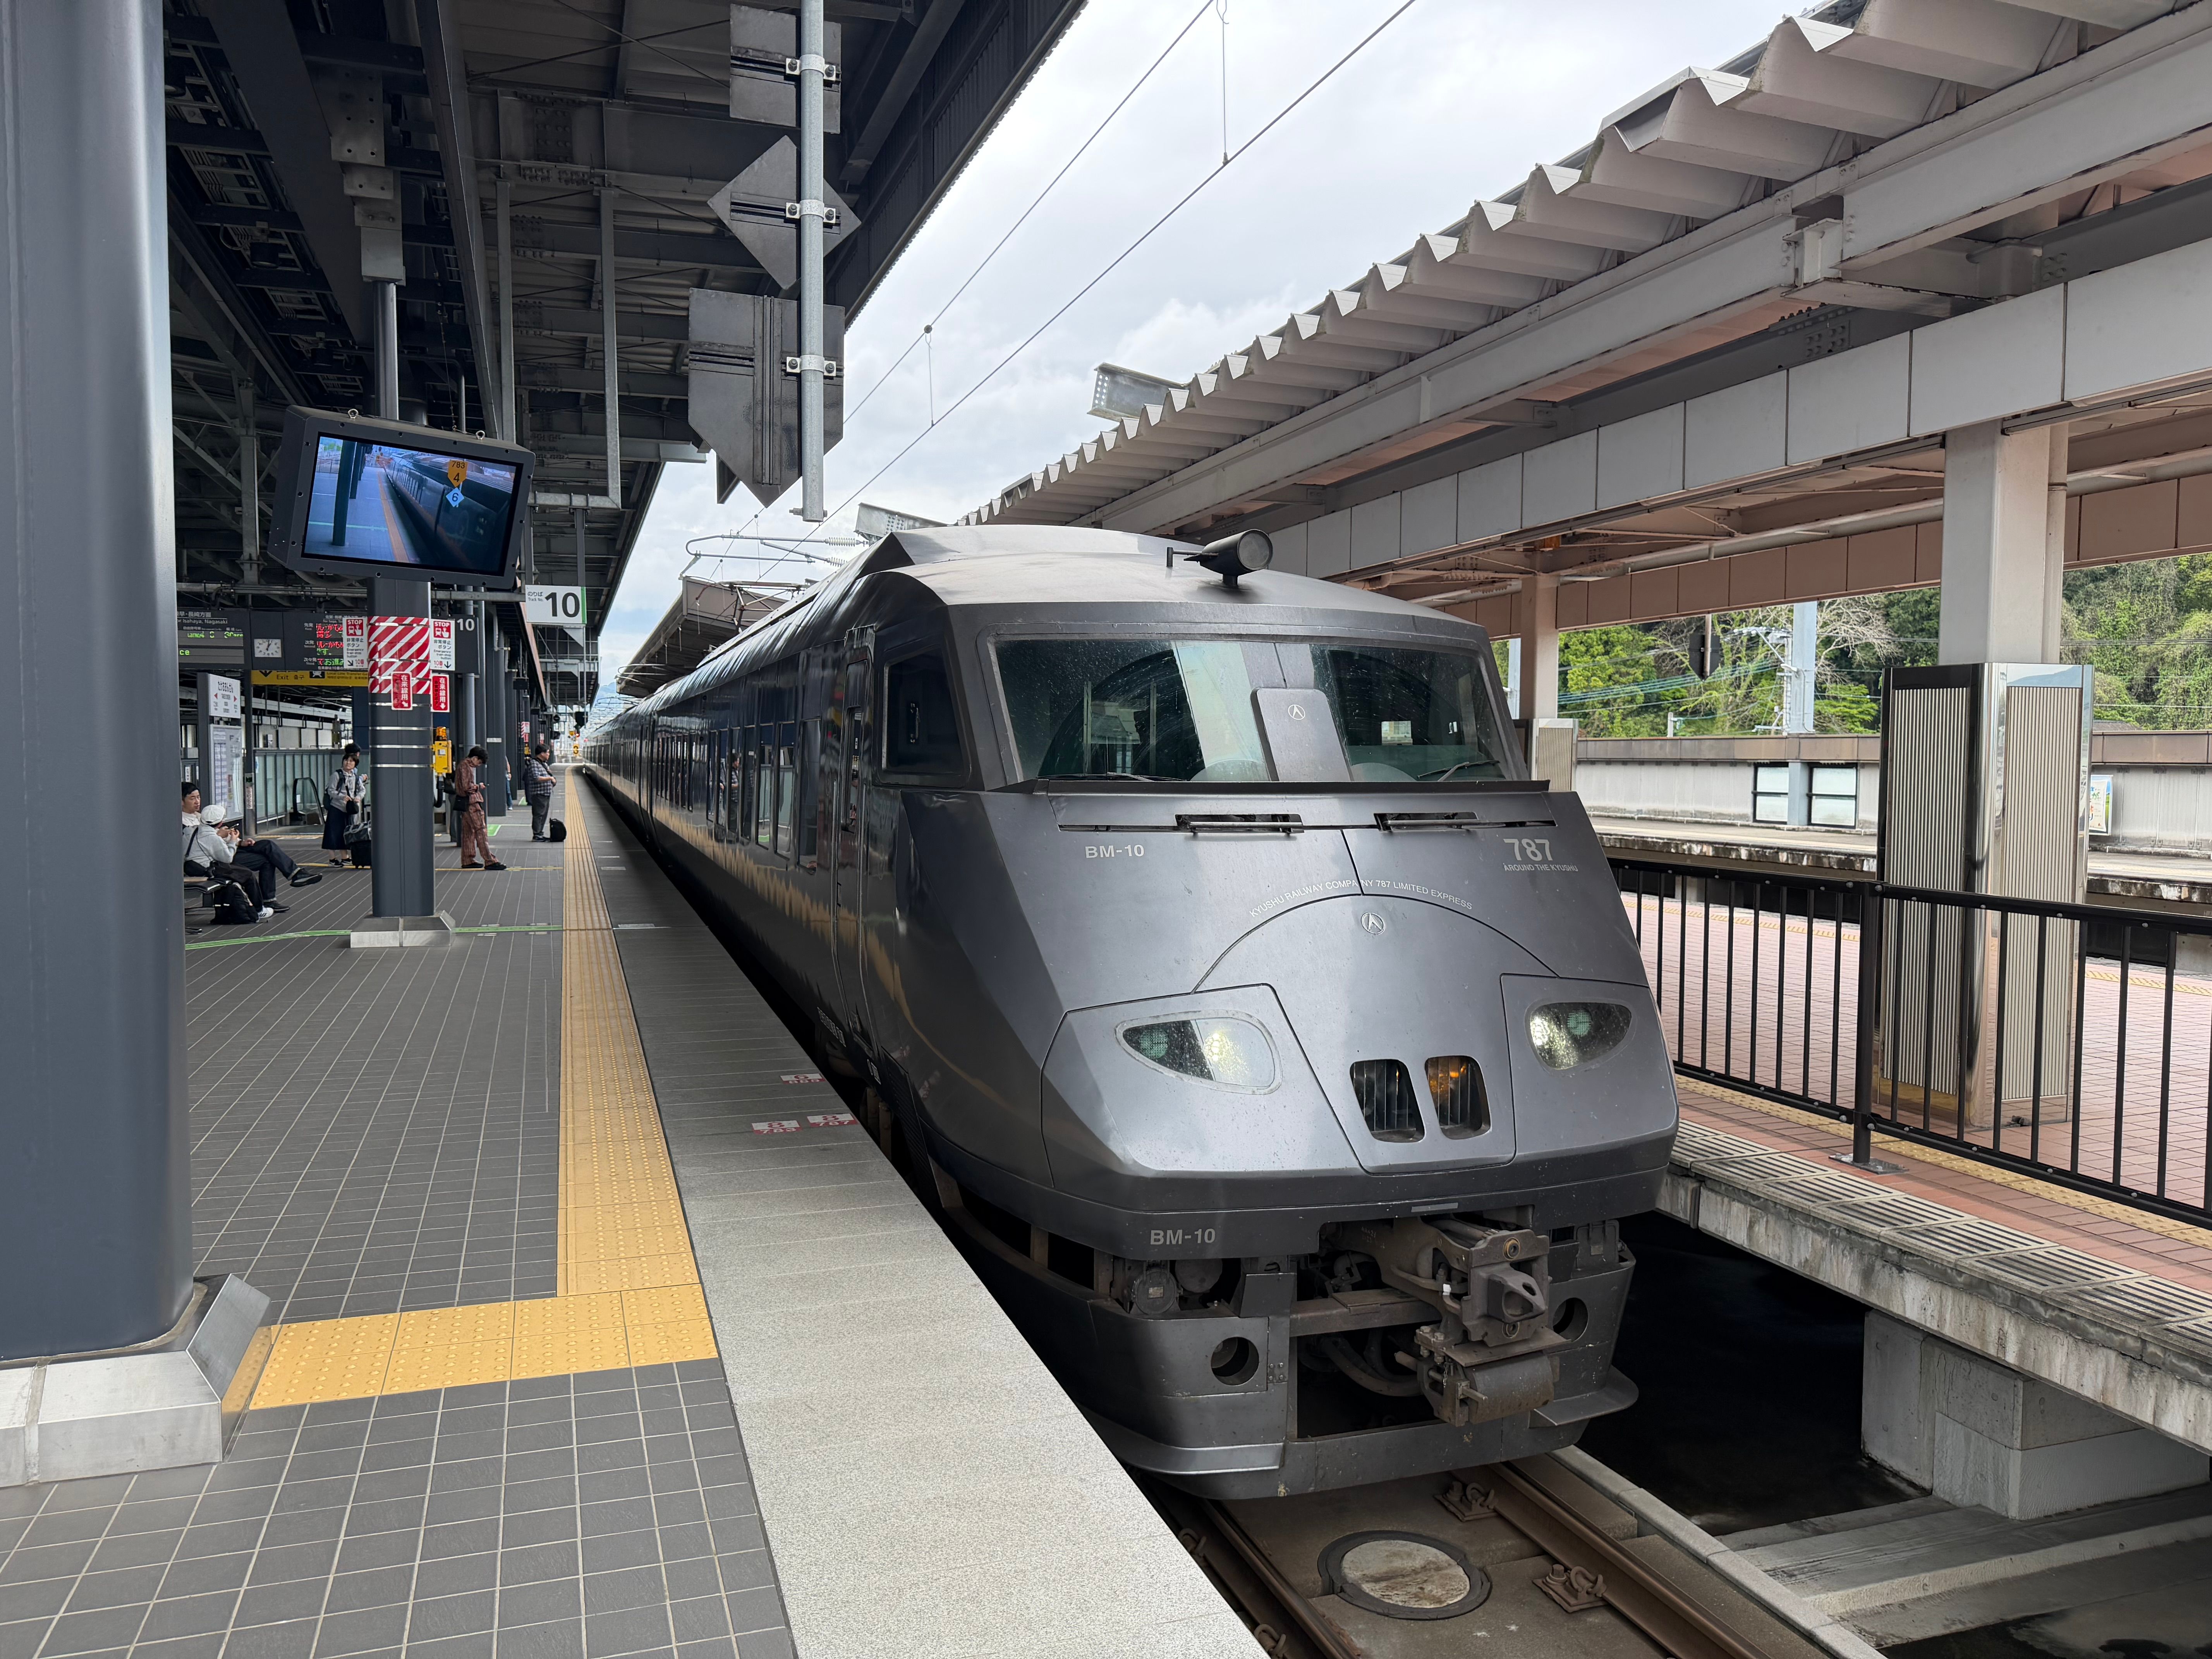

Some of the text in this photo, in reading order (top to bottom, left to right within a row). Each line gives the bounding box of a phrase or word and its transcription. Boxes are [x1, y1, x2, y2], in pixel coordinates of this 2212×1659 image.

[453, 472, 460, 482] 4
[452, 493, 459, 502] 6
[545, 592, 580, 618] 10
[457, 618, 475, 631] 10
[1085, 844, 1144, 858] BM-10
[1503, 838, 1553, 861] 787
[1249, 895, 1284, 917] KYUSHU
[1284, 883, 1323, 900] RAILWAY
[1393, 881, 1428, 894] LIMITED
[1431, 889, 1472, 910] EXPRESS
[1150, 1228, 1215, 1245] BM-10
